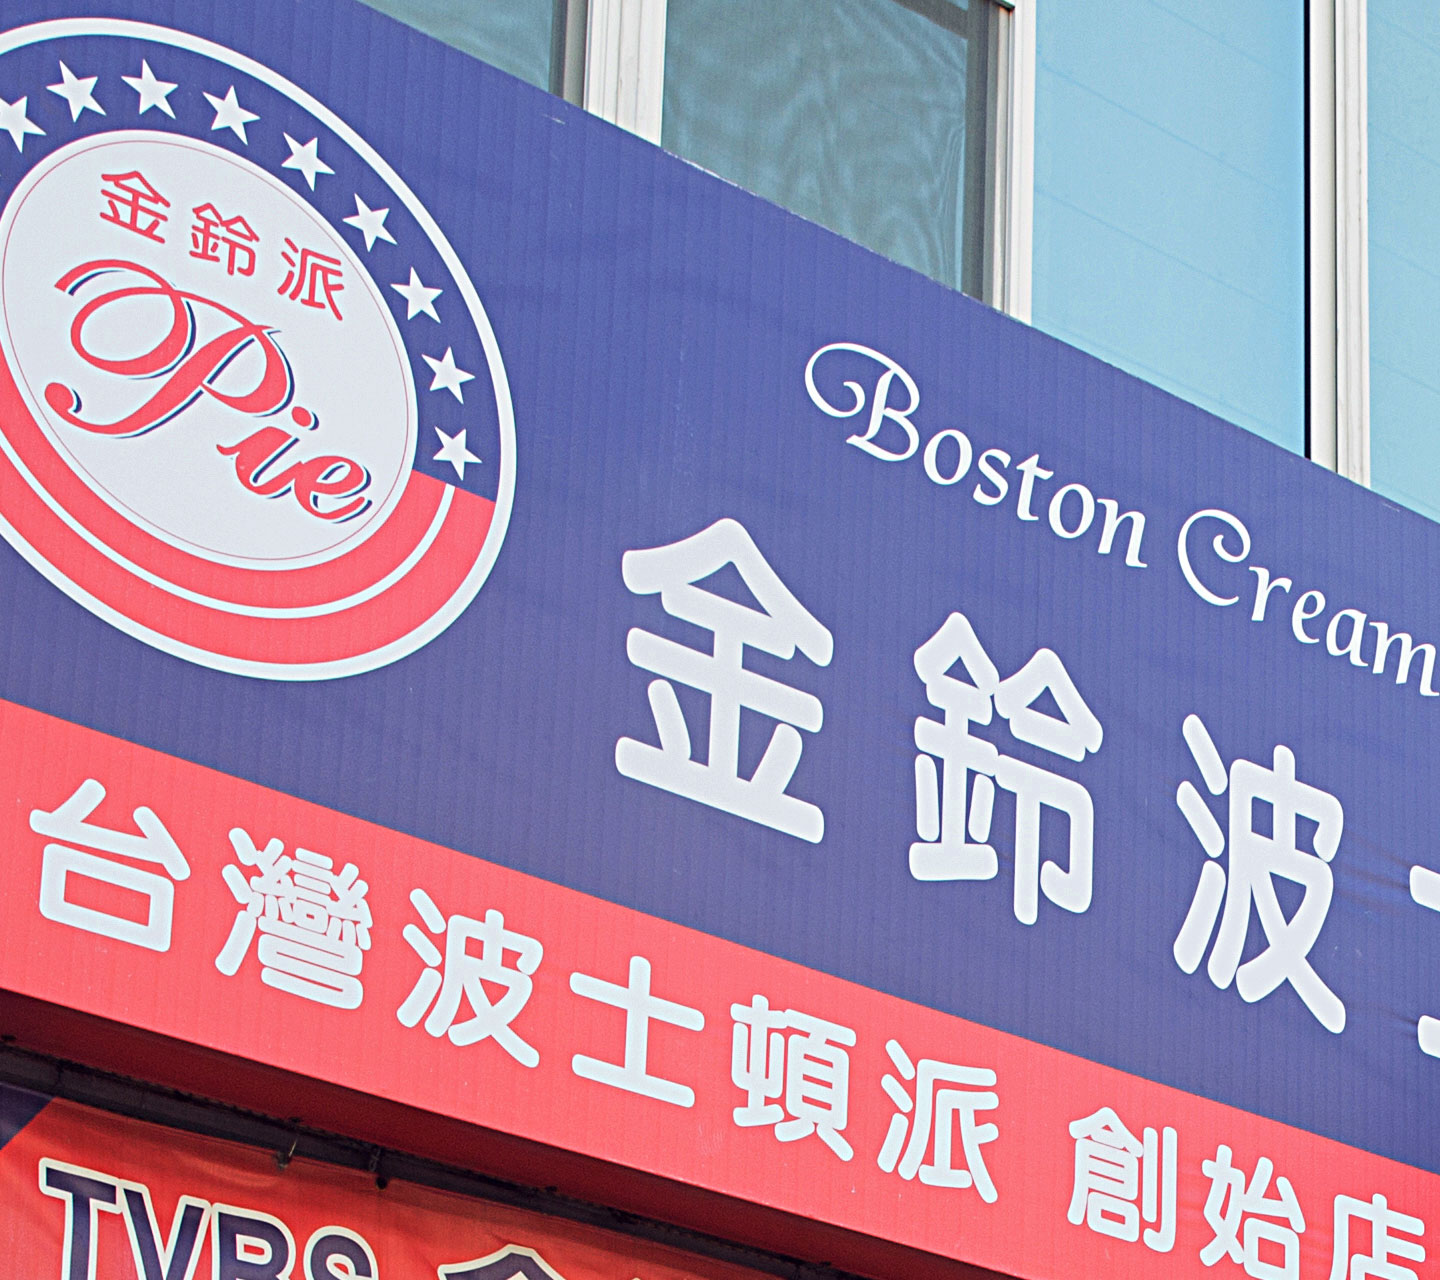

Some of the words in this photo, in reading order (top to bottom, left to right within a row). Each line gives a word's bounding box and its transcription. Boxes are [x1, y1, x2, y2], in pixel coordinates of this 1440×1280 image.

[43, 258, 372, 524] Pie
[99, 168, 346, 322] 金鈴派
[804, 341, 1148, 569] Boston
[1176, 509, 1439, 698] Cream
[29, 777, 999, 1204] 台灣波士頓派
